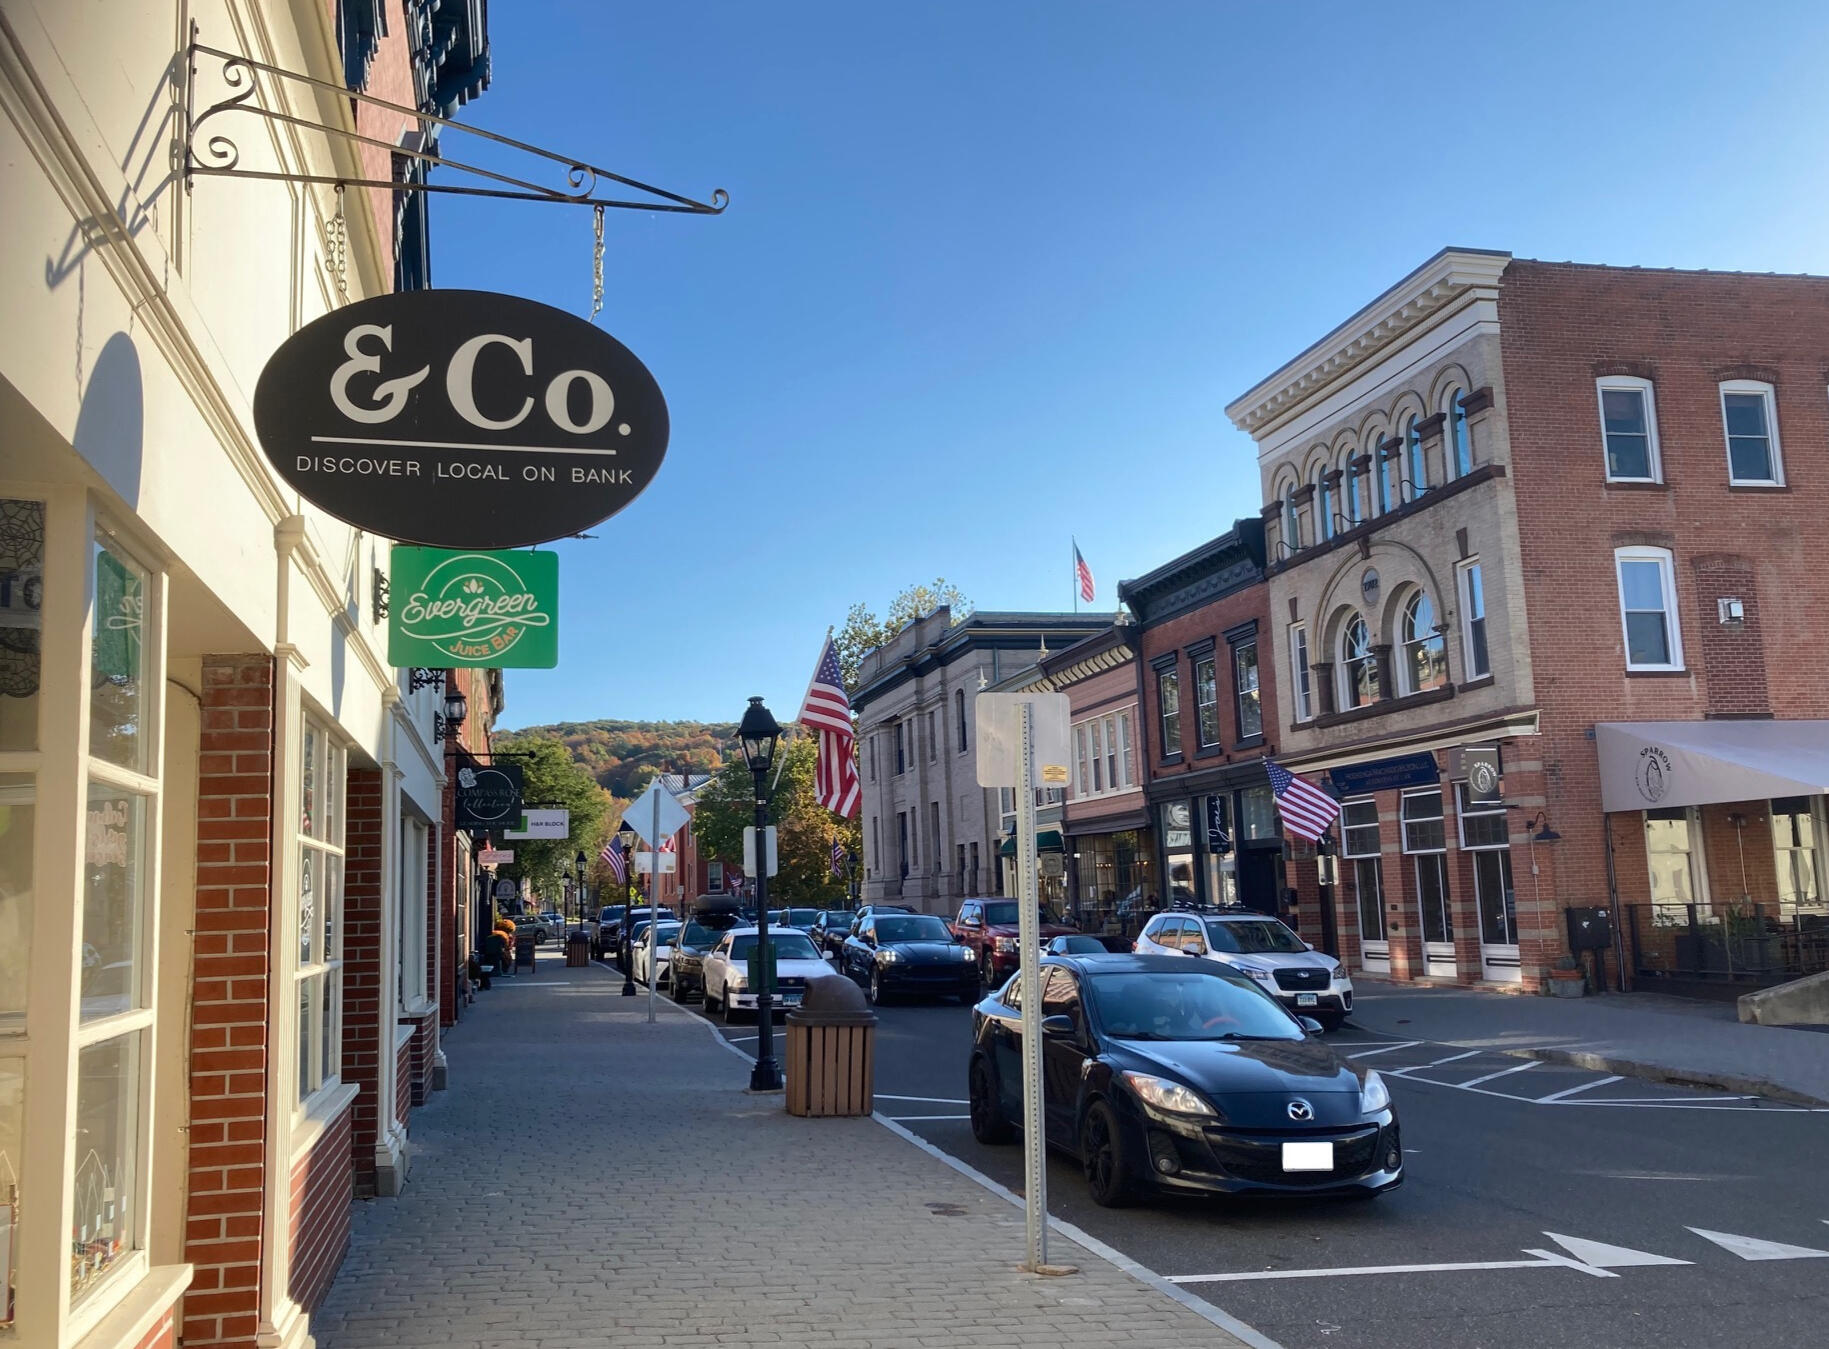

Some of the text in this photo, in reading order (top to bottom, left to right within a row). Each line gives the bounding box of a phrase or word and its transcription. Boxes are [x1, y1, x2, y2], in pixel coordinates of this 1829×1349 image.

[330, 323, 632, 436] & Co.
[296, 455, 633, 485] DISCOVER LOCAL ON BANK
[401, 592, 549, 628] Evergreen
[449, 626, 518, 656] JUICE BAR
[1640, 746, 1672, 772] SPARROW
